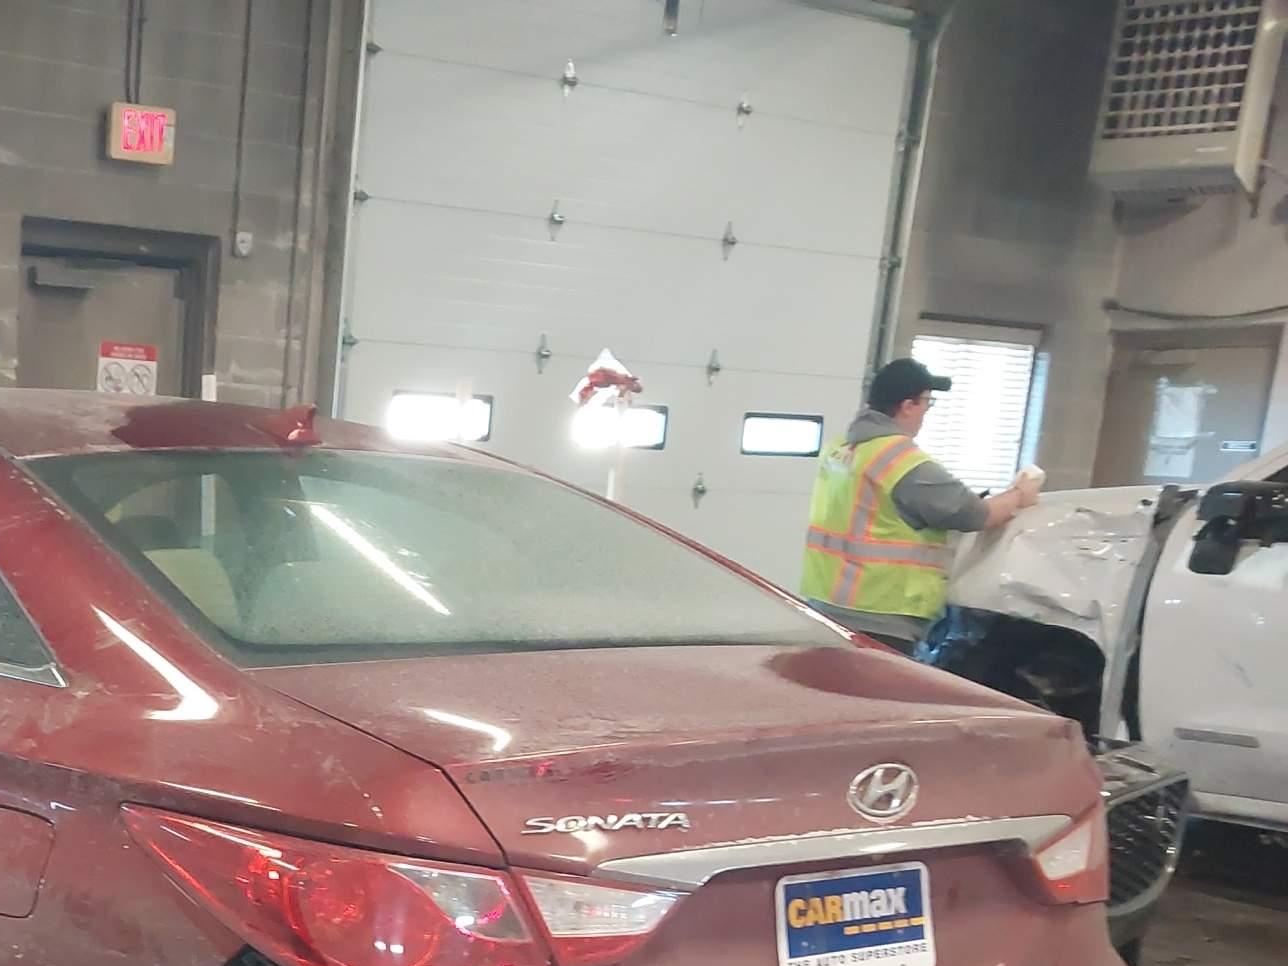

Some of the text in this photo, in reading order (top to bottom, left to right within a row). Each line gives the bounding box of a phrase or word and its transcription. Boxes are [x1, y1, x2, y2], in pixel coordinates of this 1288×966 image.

[122, 107, 168, 152] EXIT
[521, 812, 691, 835] SONATA
[851, 942, 928, 963] SUPERSTORE
